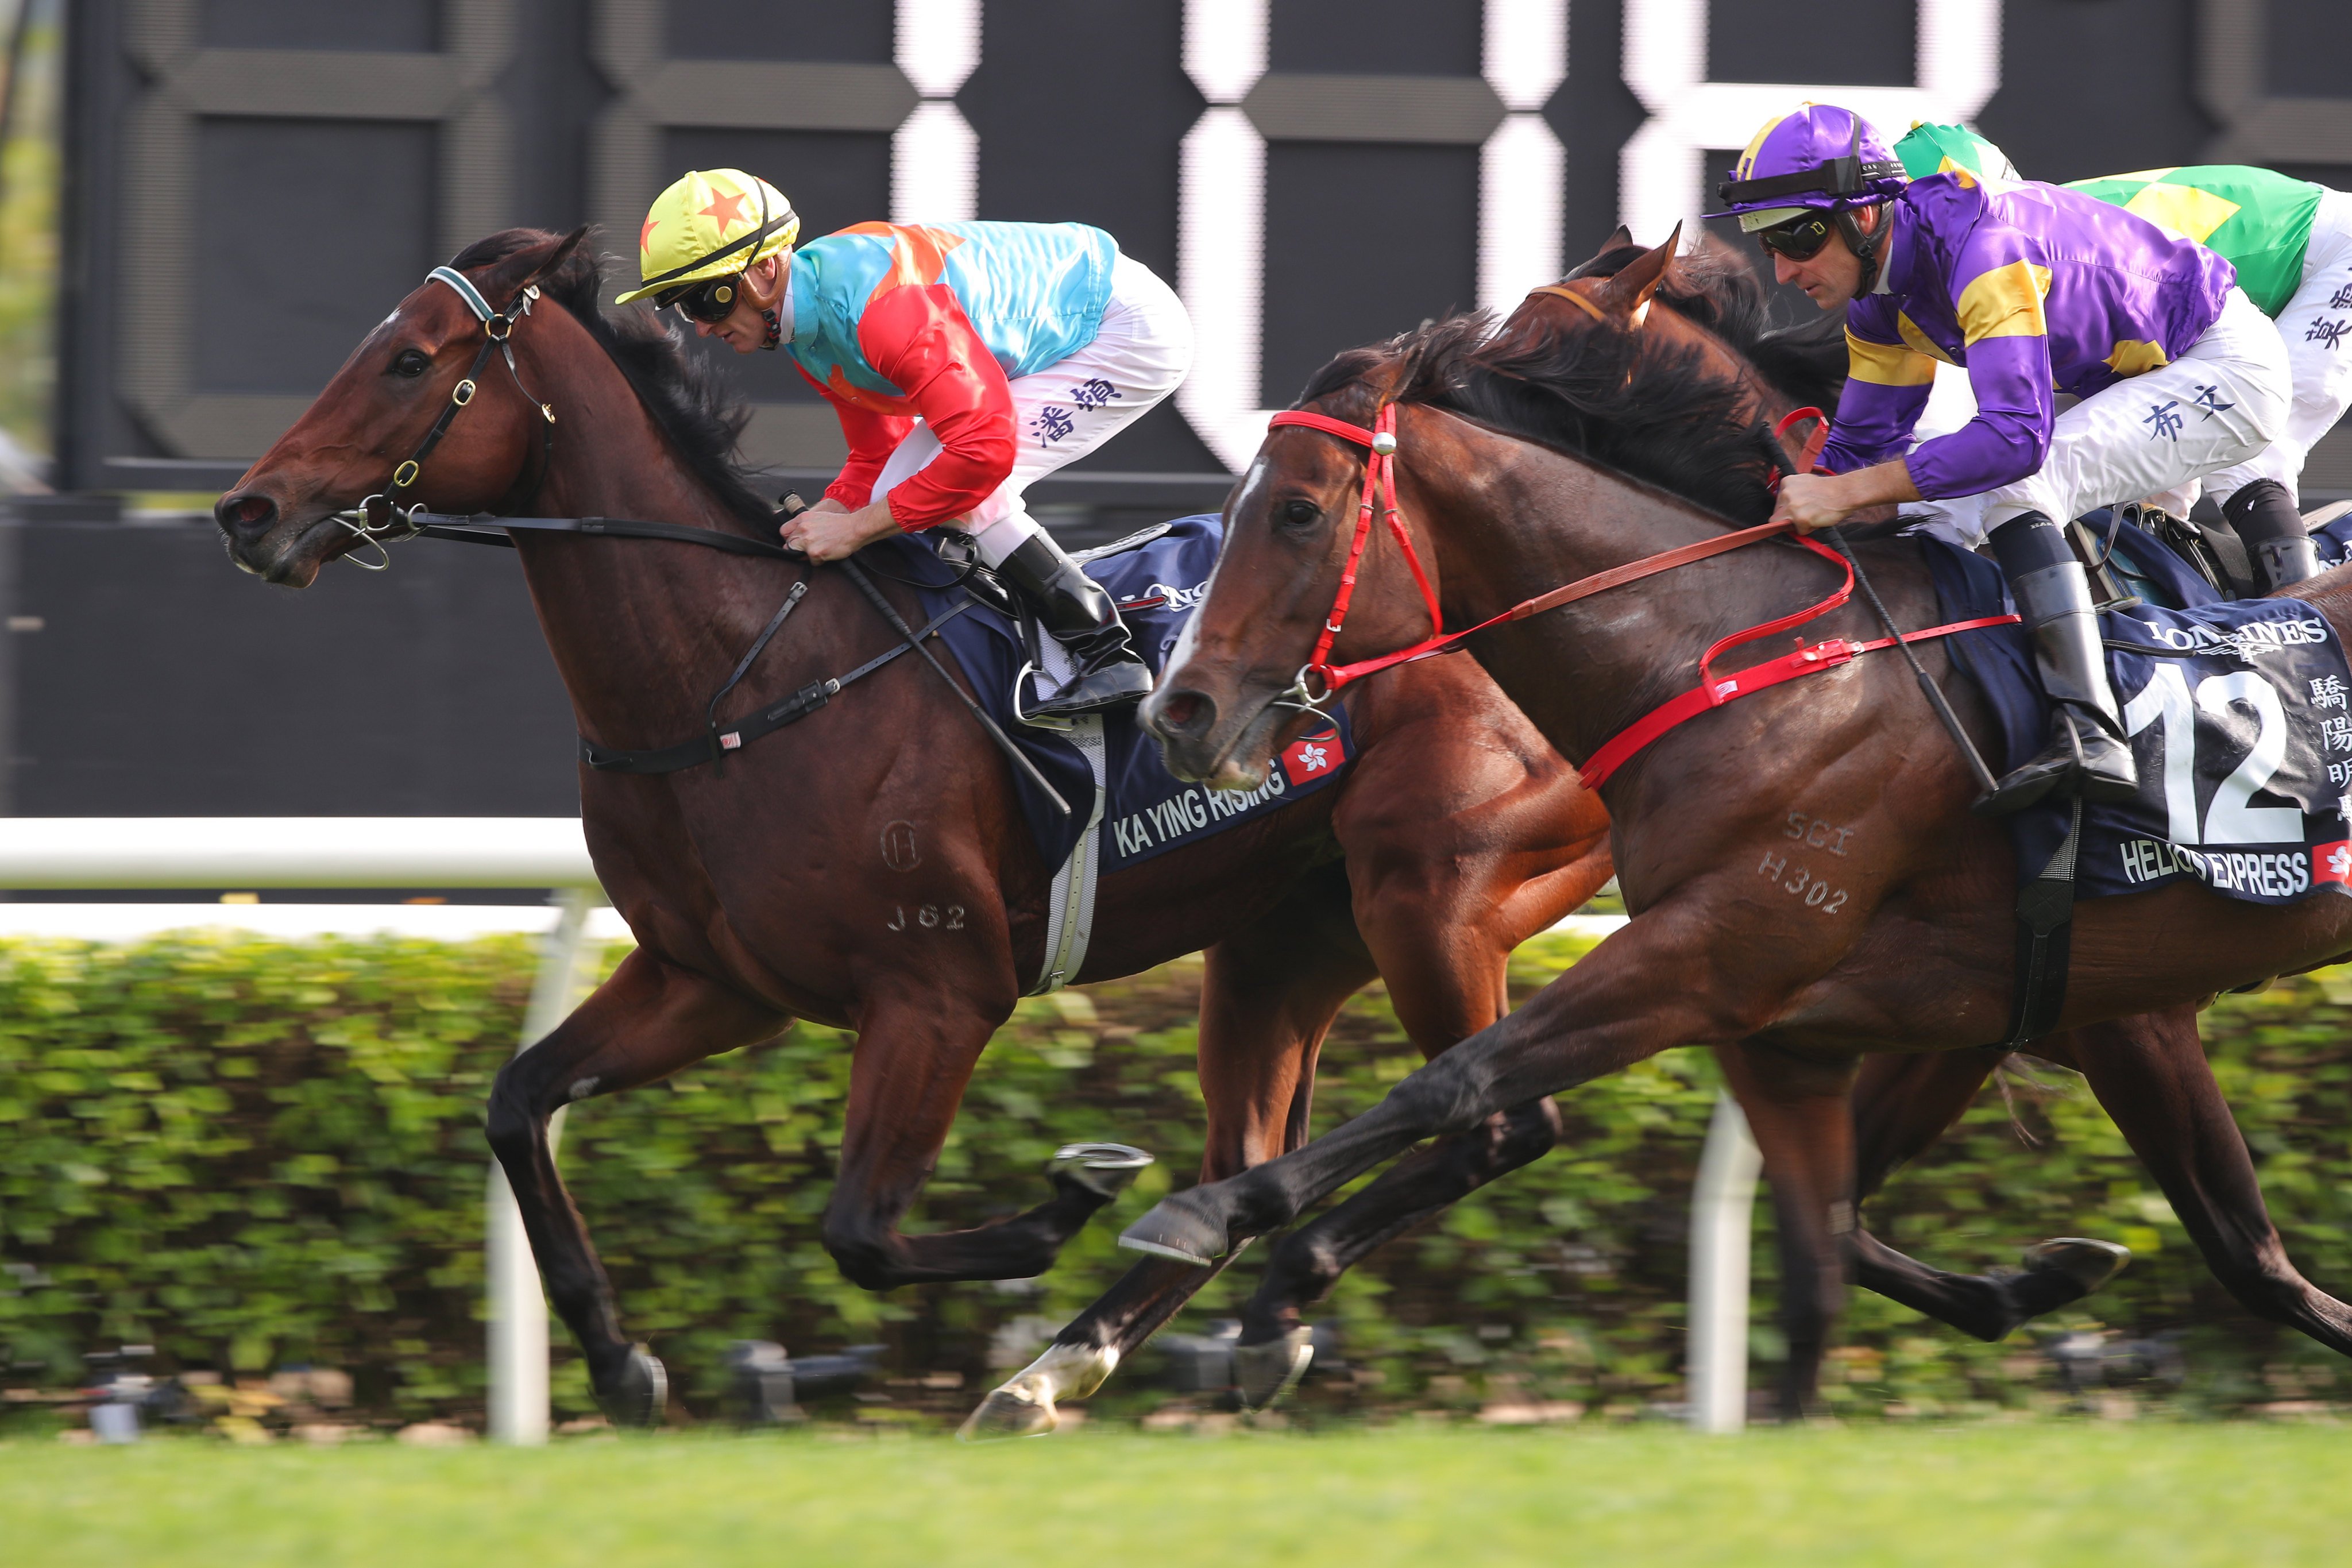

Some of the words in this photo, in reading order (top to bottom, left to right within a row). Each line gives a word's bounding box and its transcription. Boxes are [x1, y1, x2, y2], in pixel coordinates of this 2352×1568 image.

[1029, 377, 1122, 449] 潘頓
[2142, 385, 2237, 442] 布文
[2123, 662, 2305, 845] 12
[1113, 813, 1154, 858] KA
[1145, 788, 1208, 843] YING
[1758, 850, 1849, 916] H302
[2119, 840, 2207, 884] HELIOS
[2203, 851, 2309, 898] EXPRESS
